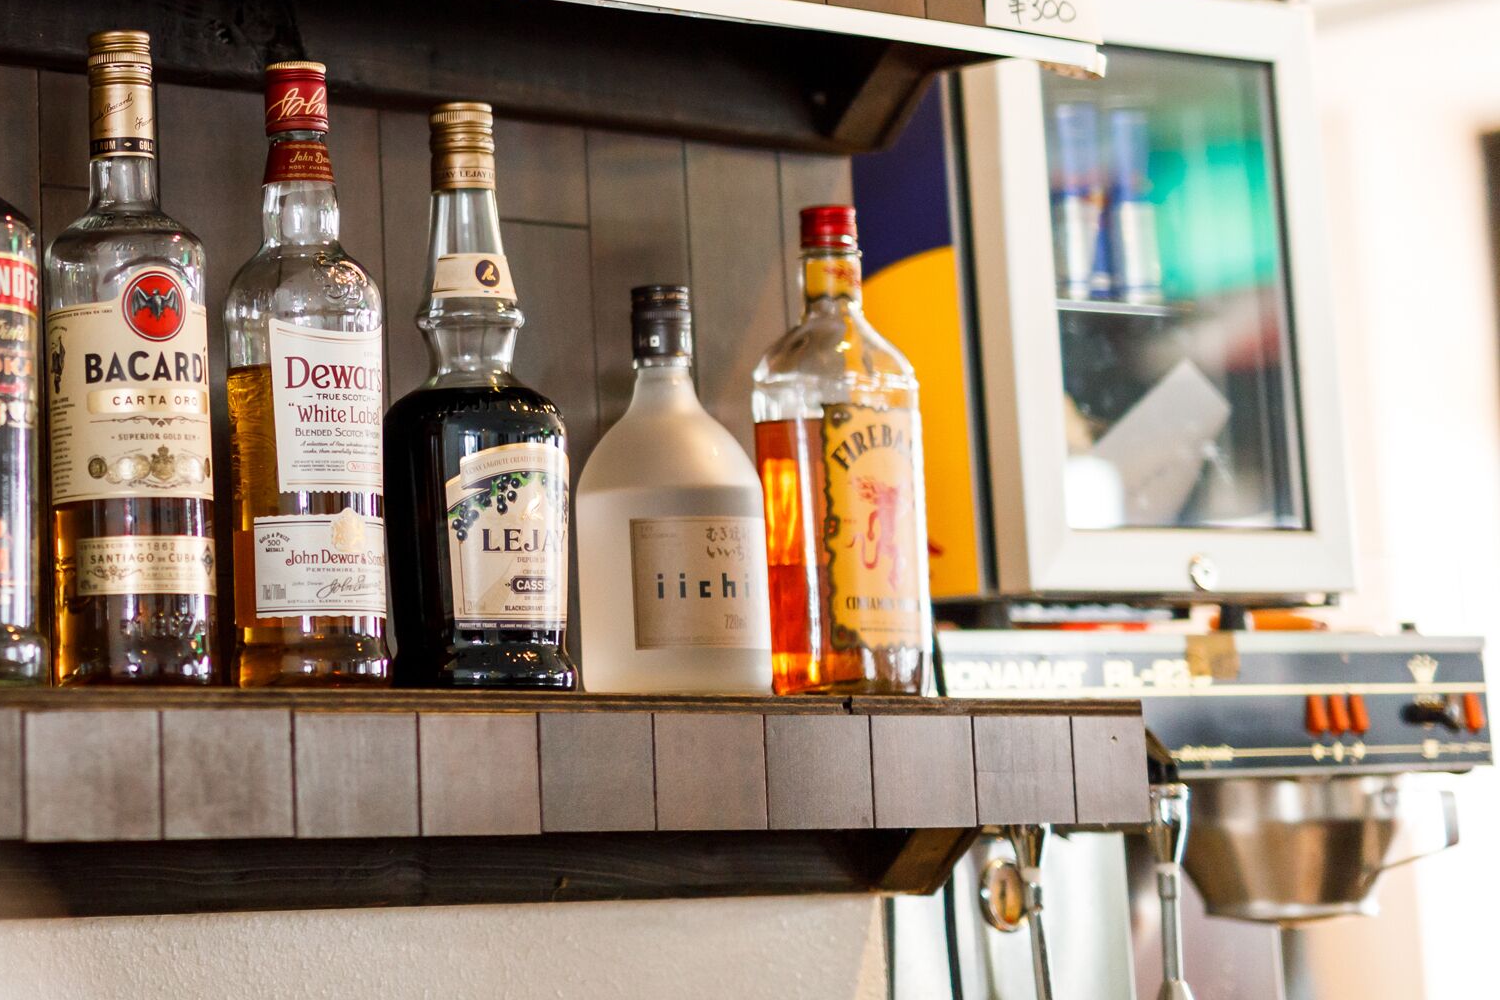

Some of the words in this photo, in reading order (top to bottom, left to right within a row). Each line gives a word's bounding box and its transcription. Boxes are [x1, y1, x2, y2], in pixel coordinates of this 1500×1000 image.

[290, 151, 314, 164] John
[459, 169, 487, 179] LEJAY
[112, 395, 167, 406] CARTA
[174, 395, 198, 407] ORO
[316, 393, 340, 401] TRUE
[118, 432, 161, 441] SUPERIOR
[163, 433, 182, 441] GOLD
[705, 526, 749, 543] むぎ焼
[147, 542, 176, 551] 1862
[90, 553, 155, 565] SANTIAGO
[168, 552, 196, 564] CUBA
[285, 549, 319, 567] John
[321, 549, 360, 566] Dewar
